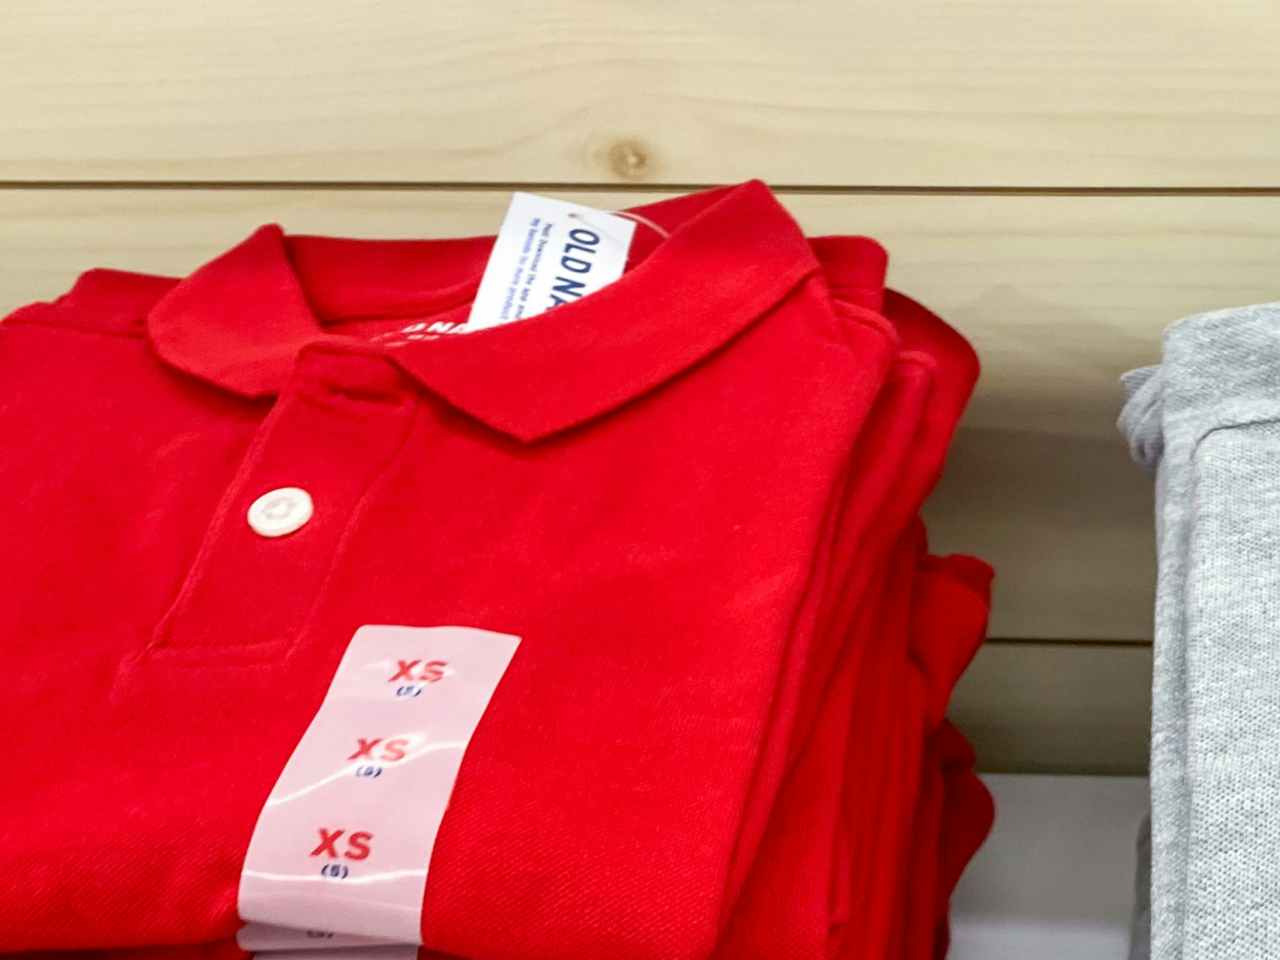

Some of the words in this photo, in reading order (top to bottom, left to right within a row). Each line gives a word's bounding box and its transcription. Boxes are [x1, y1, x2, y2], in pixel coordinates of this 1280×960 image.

[561, 228, 600, 274] OLD
[546, 276, 586, 310] NA
[387, 659, 449, 683] XS
[347, 738, 409, 762] XS
[309, 828, 373, 860] XS
[321, 864, 348, 879] (5)
